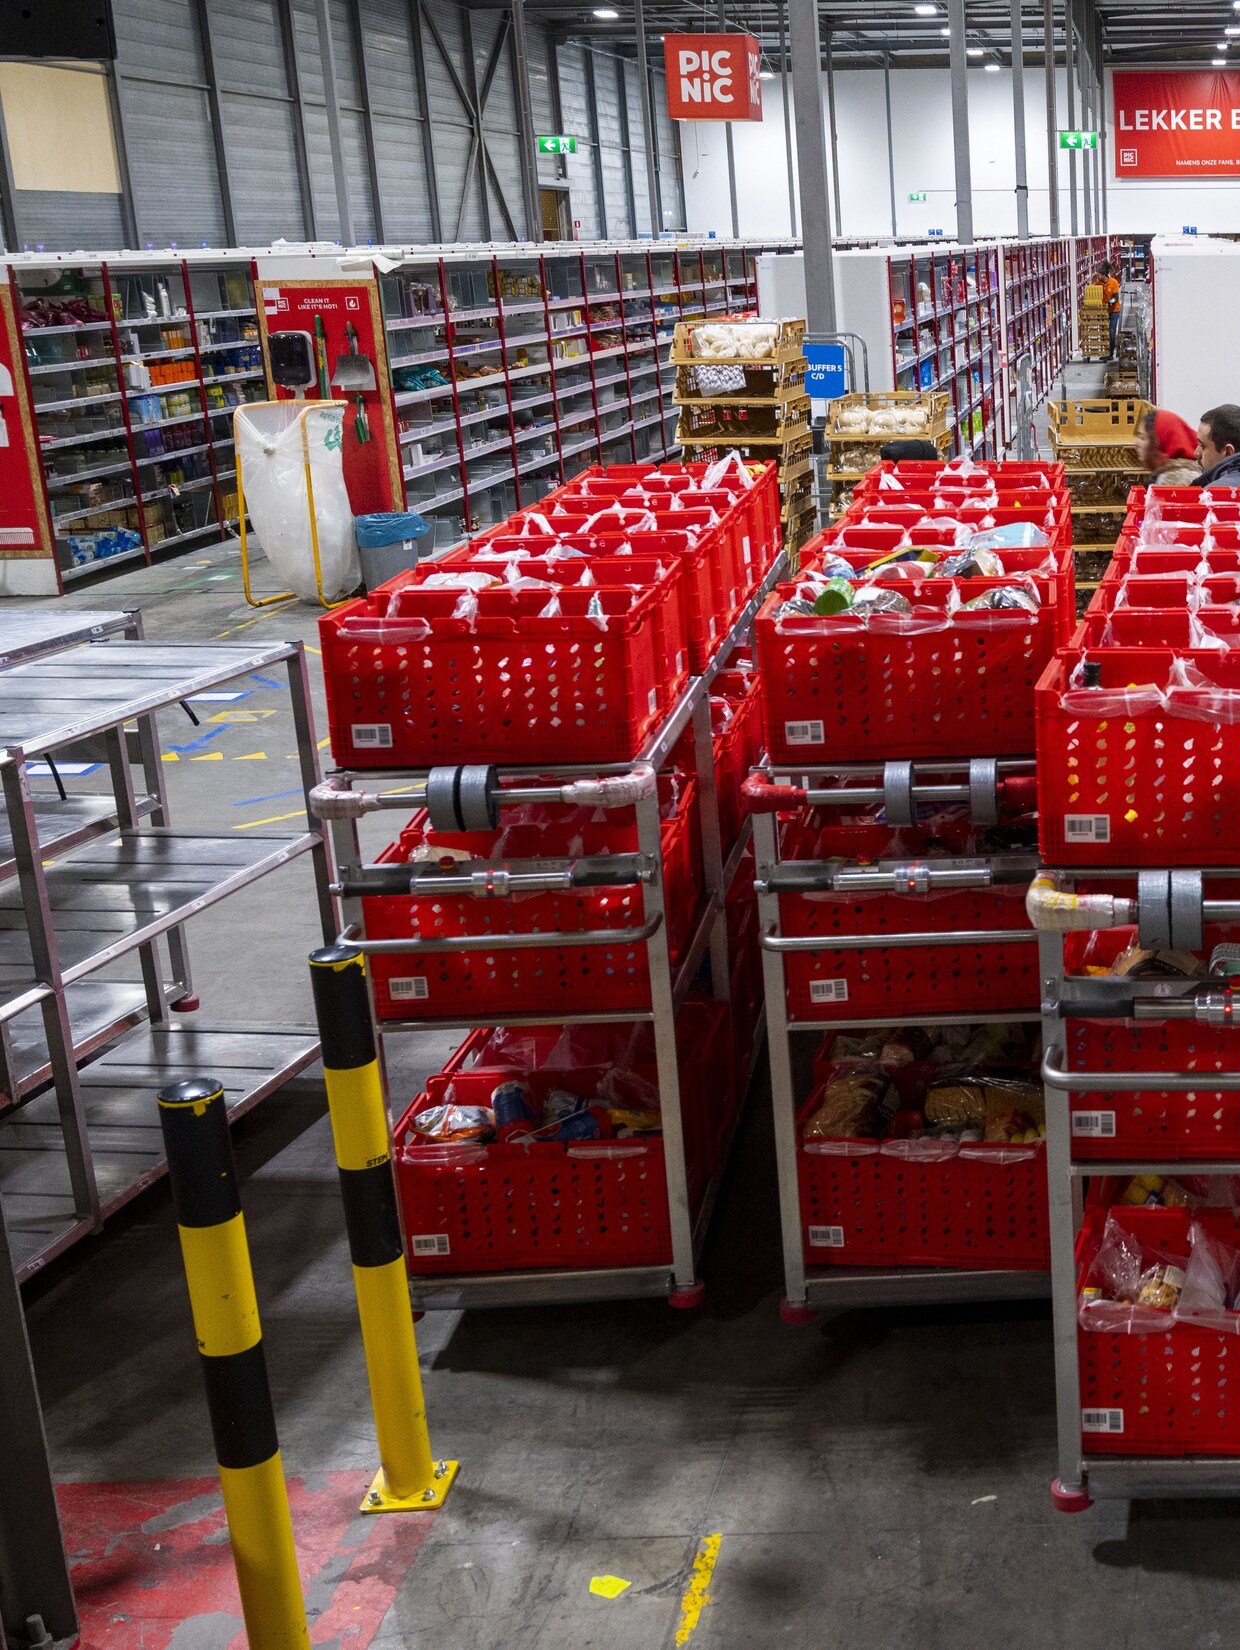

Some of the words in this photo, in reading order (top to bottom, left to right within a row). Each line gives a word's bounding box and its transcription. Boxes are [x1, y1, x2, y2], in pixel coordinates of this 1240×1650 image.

[678, 50, 733, 76] PIC
[1119, 109, 1222, 131] LEKKER
[807, 363, 837, 372] BUFFER
[810, 372, 825, 380] C/D
